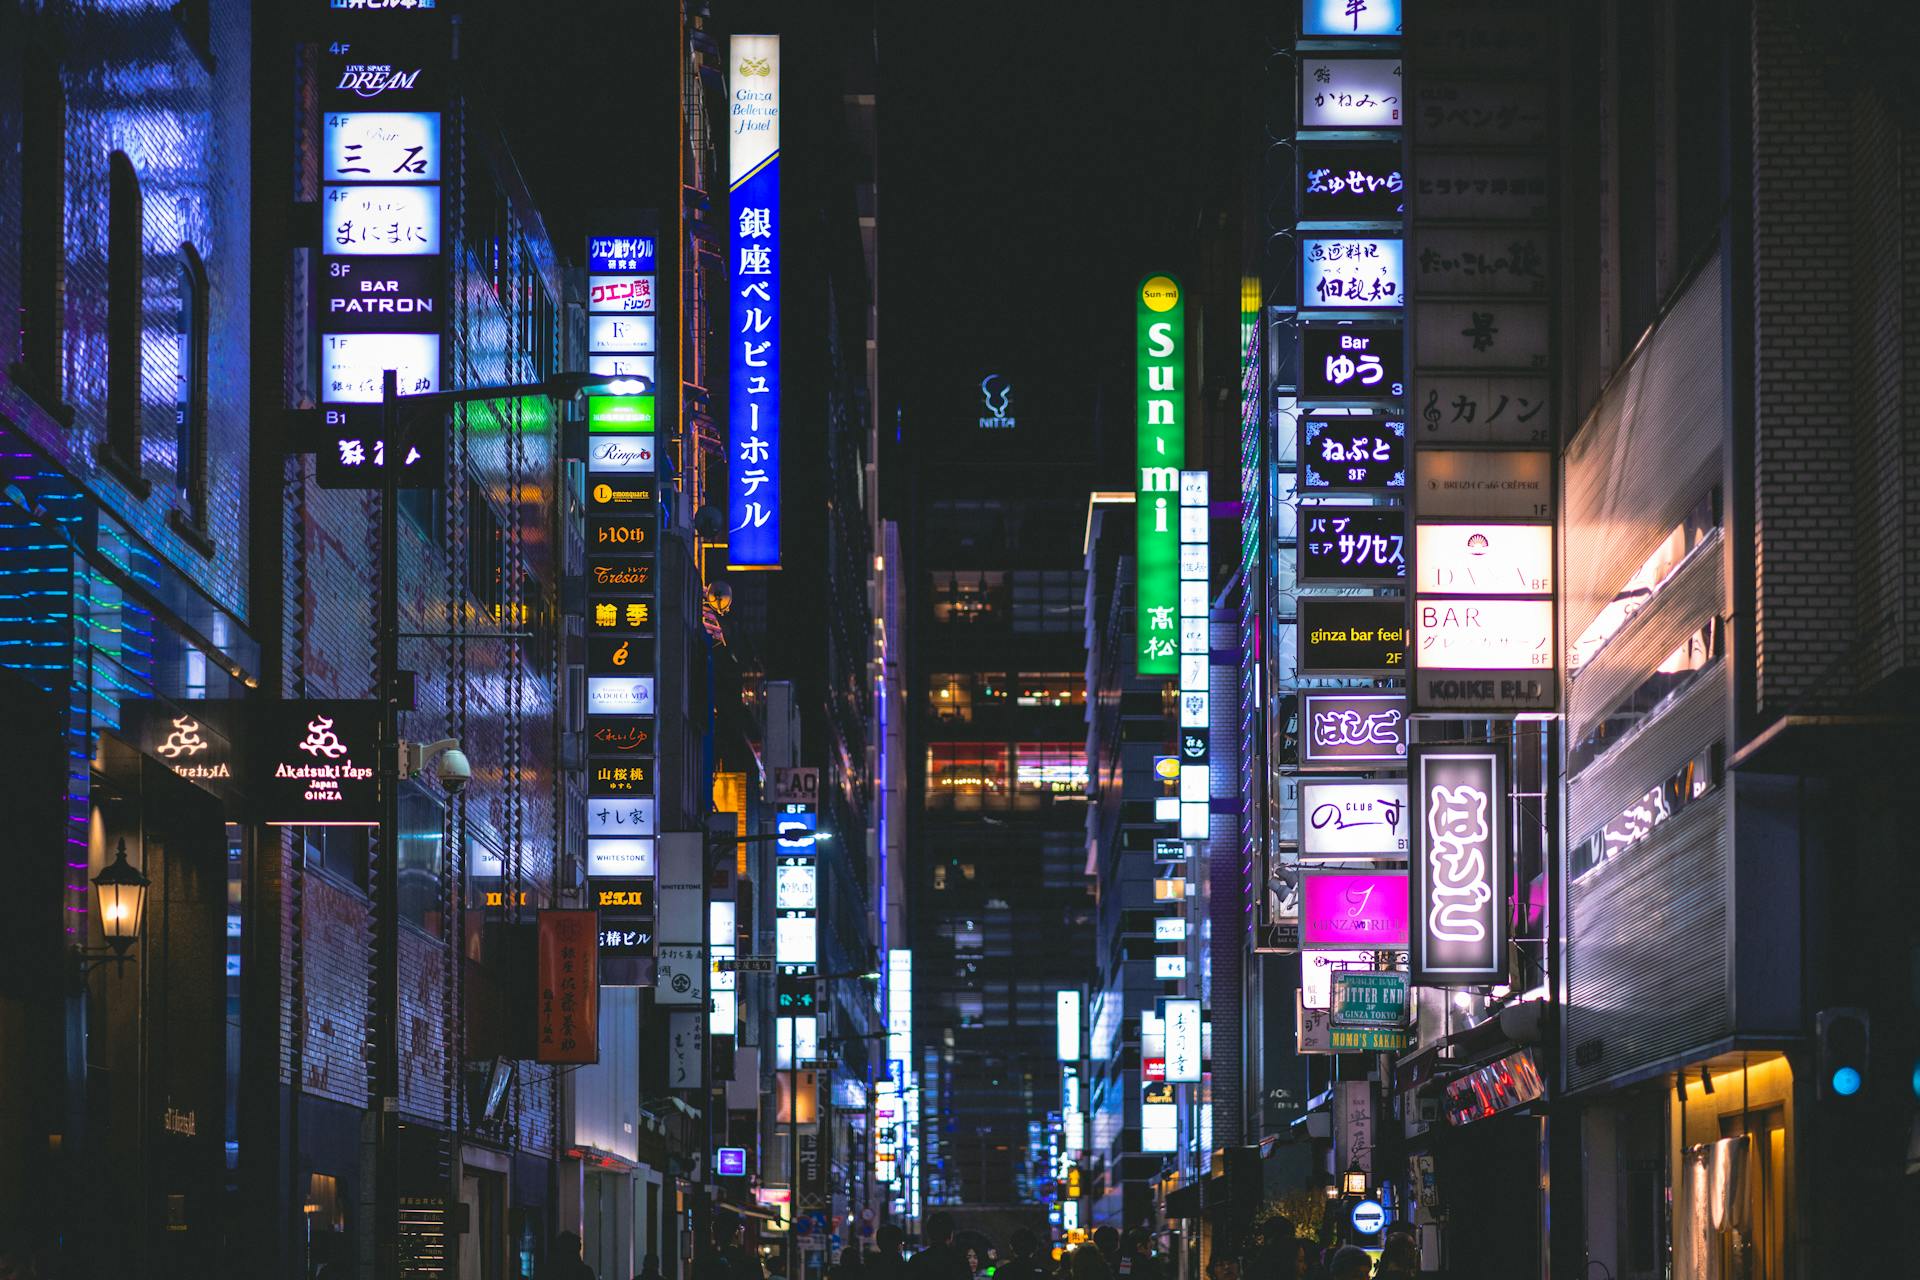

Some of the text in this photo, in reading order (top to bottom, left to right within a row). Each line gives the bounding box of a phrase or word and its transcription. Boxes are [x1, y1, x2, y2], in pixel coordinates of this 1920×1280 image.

[329, 42, 350, 54] 4F
[336, 69, 421, 94] DREAM
[736, 89, 772, 101] Ginza
[1315, 92, 1398, 107] かねみつ
[732, 104, 778, 116] Bellevue
[329, 116, 349, 128] 4F
[734, 119, 770, 134] Hotel
[328, 190, 348, 202] 4F
[336, 221, 427, 244] まにまに
[592, 239, 653, 258] クエン酸サイクル
[330, 263, 350, 277] 3F
[608, 260, 636, 269] 研究会
[361, 281, 399, 291] BAR
[591, 279, 649, 303] クエン酸
[331, 299, 432, 312] PATRON
[329, 338, 347, 349] 1F
[1341, 336, 1369, 349] Bar
[739, 207, 771, 529] 銀座ベルビューホテル
[1325, 355, 1384, 384] ゆう
[1391, 384, 1403, 395] 3
[1451, 394, 1544, 424] カノン
[326, 412, 346, 424] B1
[979, 418, 1015, 428] NITTA
[1531, 431, 1547, 441] 2F
[593, 443, 640, 467] Ringo
[1322, 438, 1390, 461] ねぷと
[1348, 469, 1366, 480] 3F
[1533, 504, 1548, 516] 1F
[1310, 517, 1350, 533] パブ
[1309, 535, 1405, 564] モア サクセス
[594, 567, 648, 584] Trésor
[1532, 579, 1549, 590] BF
[1423, 607, 1480, 628] BAR
[1144, 605, 1178, 661] 高松
[1310, 628, 1402, 644] ginza bar feel
[1386, 653, 1402, 664] 2F
[1532, 653, 1549, 664] BF
[1430, 680, 1495, 700] KOIKE
[1314, 709, 1401, 746] はしご
[275, 760, 373, 779] Akatsuki Taps
[598, 768, 644, 781] 山桜桃
[310, 780, 338, 789] Japan
[304, 792, 342, 800] GINZA
[1346, 802, 1373, 811] CLUB
[597, 808, 645, 825] すし家
[1429, 785, 1491, 942] はしご
[1384, 988, 1403, 1004] END
[1345, 1010, 1397, 1019] GINZA TOKYO
[1333, 1033, 1367, 1048] MOMO'S
